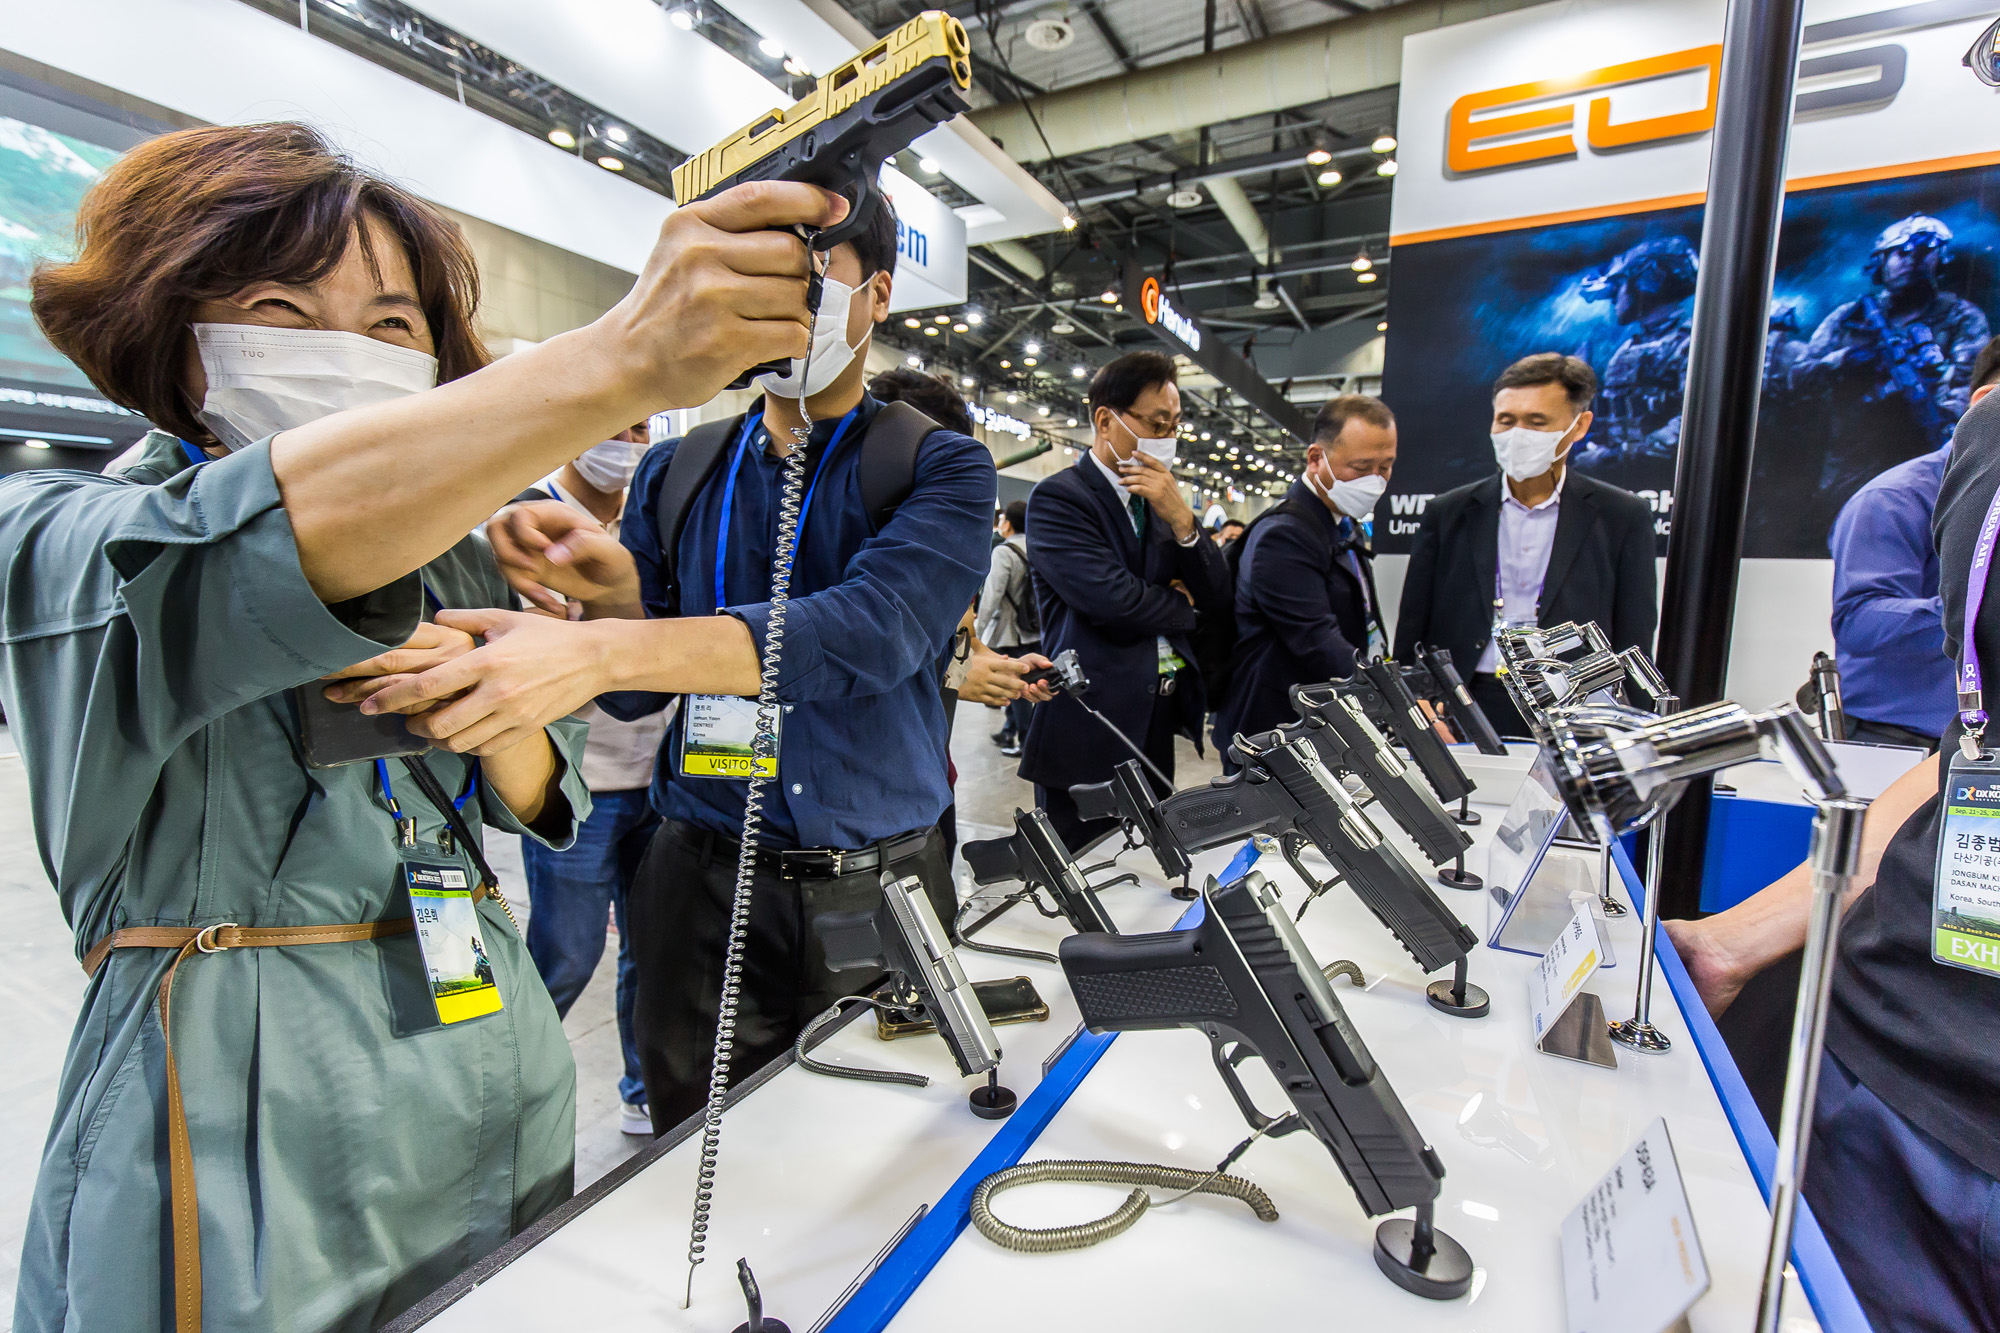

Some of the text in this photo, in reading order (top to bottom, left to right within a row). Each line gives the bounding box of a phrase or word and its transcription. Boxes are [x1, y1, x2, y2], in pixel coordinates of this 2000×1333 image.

[241, 350, 265, 358] TUO
[1975, 542, 1989, 570] AIR
[1951, 869, 1989, 880] JONGBUM
[1950, 878, 1977, 888] DASAN
[1950, 892, 1975, 905] Korea,
